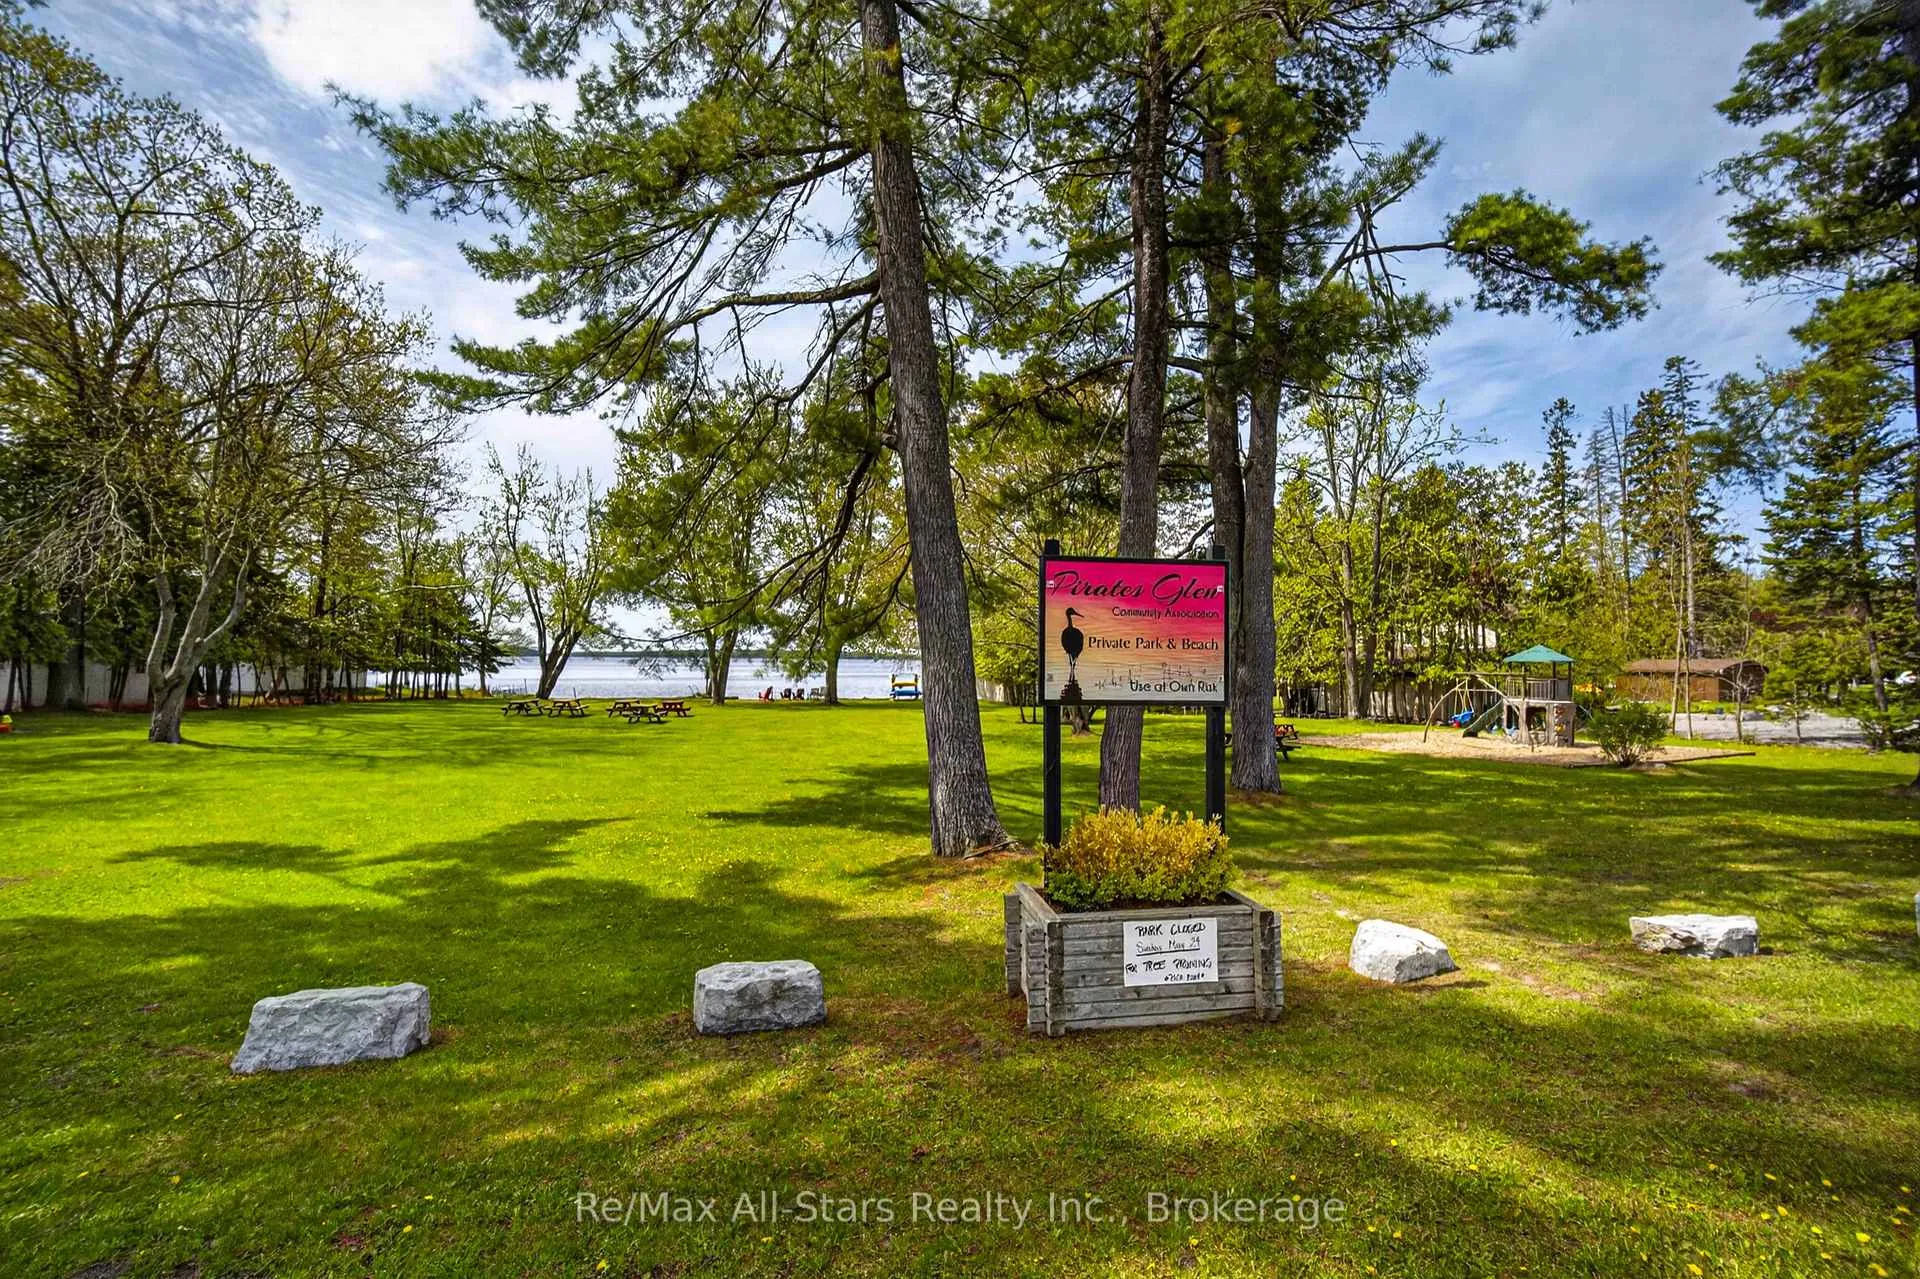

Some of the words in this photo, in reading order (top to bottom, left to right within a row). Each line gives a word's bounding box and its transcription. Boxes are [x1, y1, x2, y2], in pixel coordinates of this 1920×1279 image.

[1051, 570, 1144, 598] Pirates
[1152, 573, 1219, 606] Glen
[1112, 606, 1162, 619] Community
[1164, 608, 1219, 619] Association
[1088, 636, 1131, 650] Private
[1135, 637, 1162, 650] Park
[1167, 637, 1177, 650] &
[1182, 637, 1218, 651] Beach
[1130, 679, 1151, 693] Use
[1154, 681, 1166, 693] at
[1169, 680, 1195, 693] Own
[1198, 680, 1218, 693] Risk
[1135, 923, 1163, 937] PARK
[1170, 922, 1206, 936] CLOSED
[1168, 939, 1185, 951] May
[1143, 960, 1166, 972] TREE
